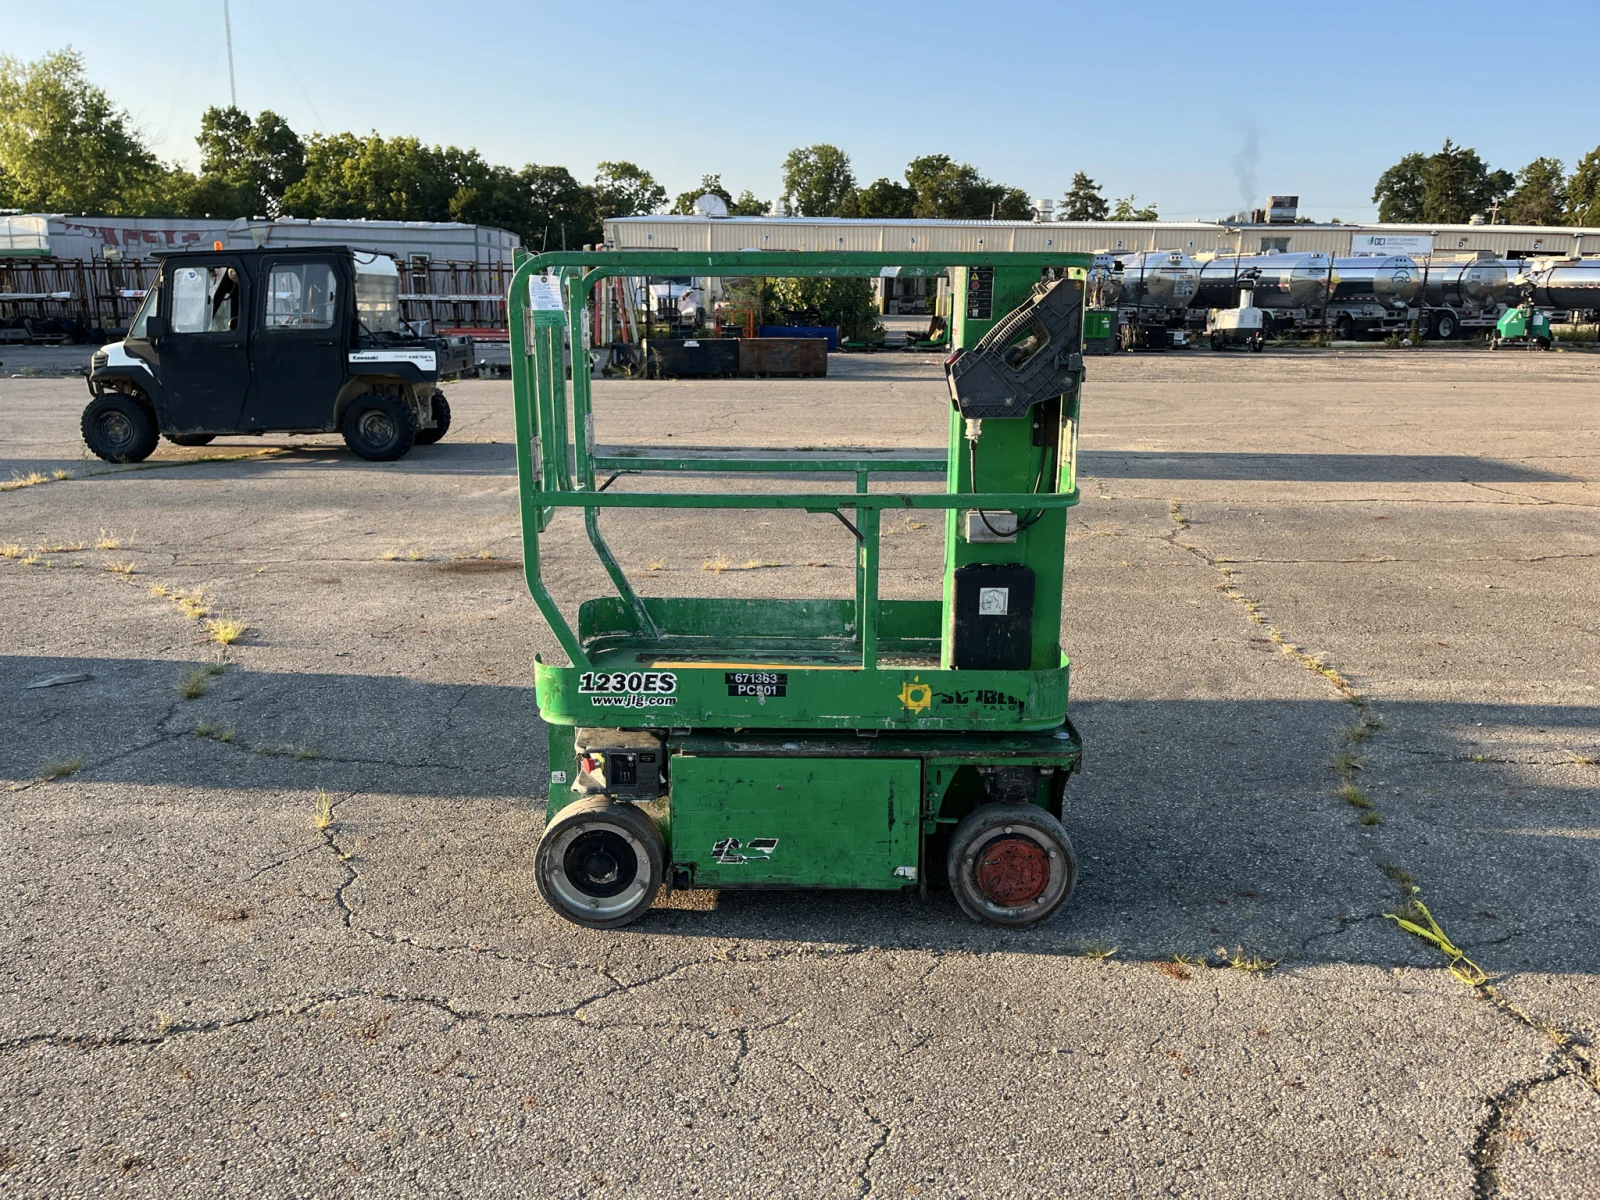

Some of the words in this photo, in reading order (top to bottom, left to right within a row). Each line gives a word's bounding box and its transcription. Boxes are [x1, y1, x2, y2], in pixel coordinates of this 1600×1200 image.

[1374, 237, 1386, 246] DCI
[578, 672, 677, 694] 1230ES
[735, 673, 777, 684] 671363
[592, 694, 677, 708] www.jlg.com
